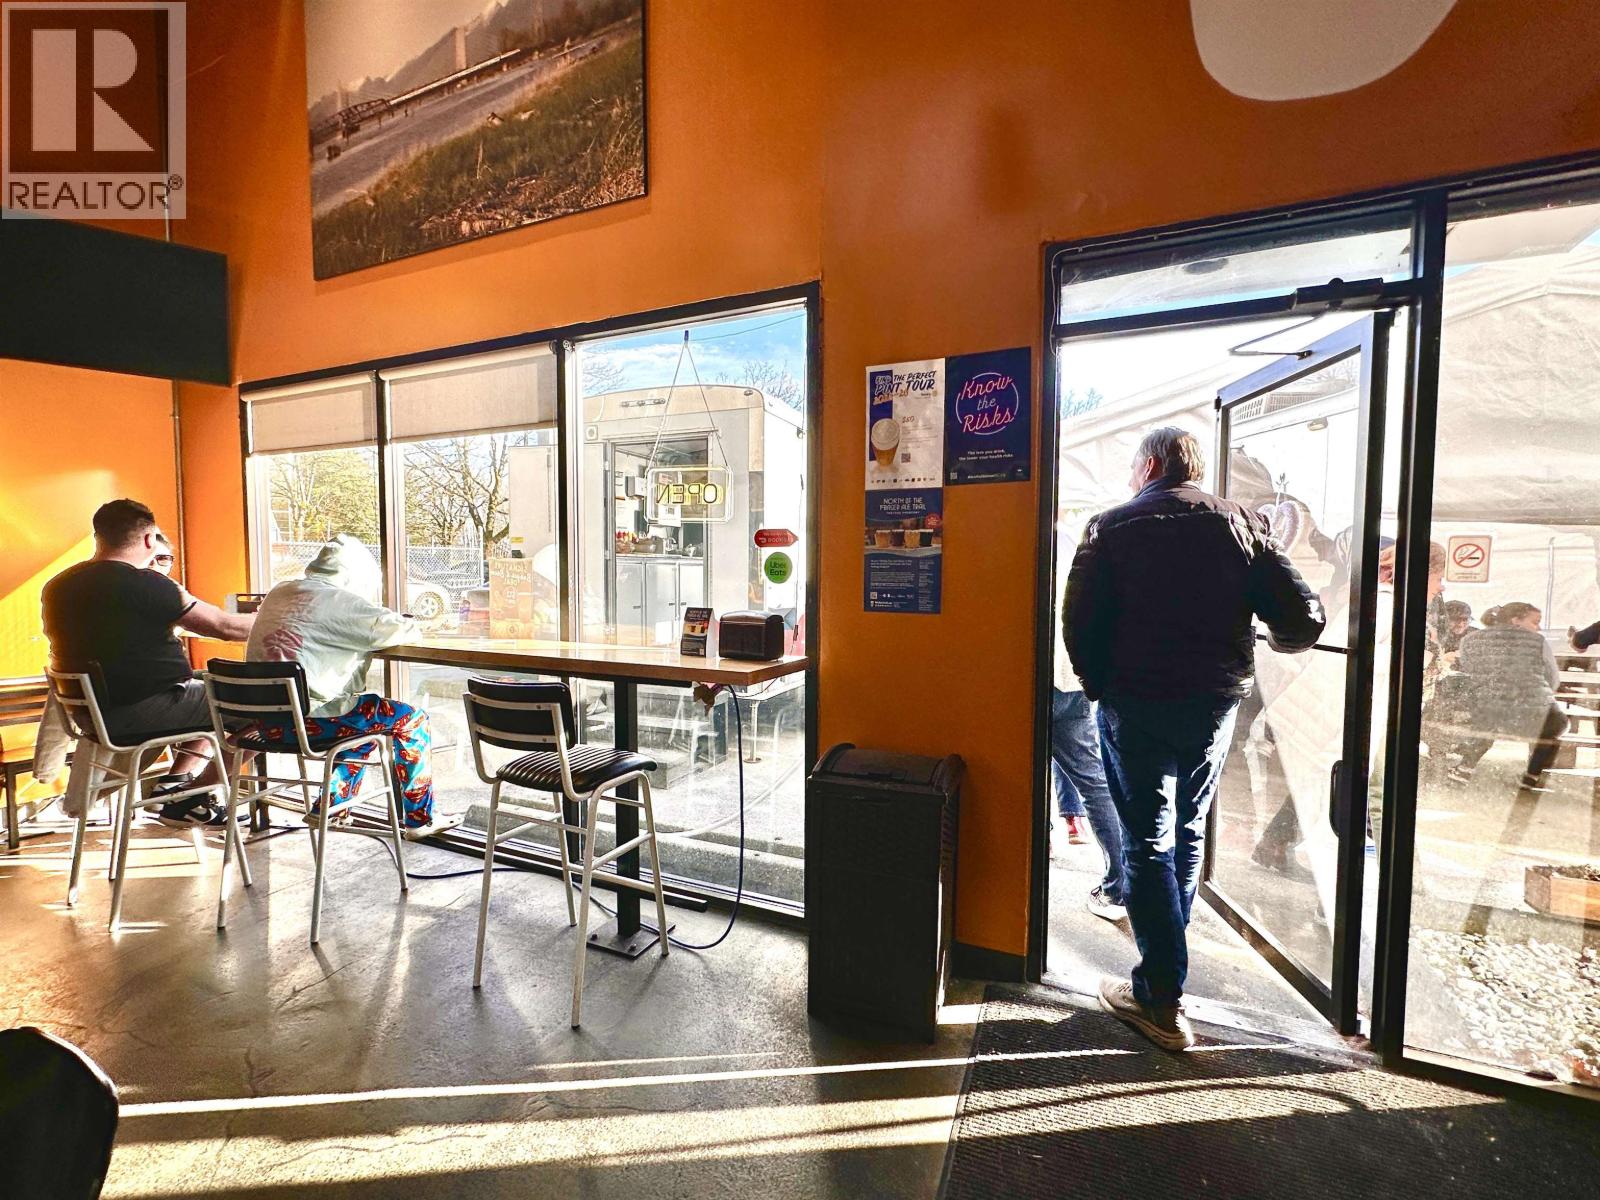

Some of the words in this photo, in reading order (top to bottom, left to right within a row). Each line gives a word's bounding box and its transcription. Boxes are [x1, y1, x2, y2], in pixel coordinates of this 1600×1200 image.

[894, 374, 906, 382] THE
[907, 371, 937, 380] PERFECT
[875, 382, 902, 395] PINT
[906, 379, 936, 391] TOUR
[961, 376, 1013, 400] Know
[977, 394, 997, 410] the
[963, 405, 1015, 432] Risks
[770, 561, 786, 569] Uber
